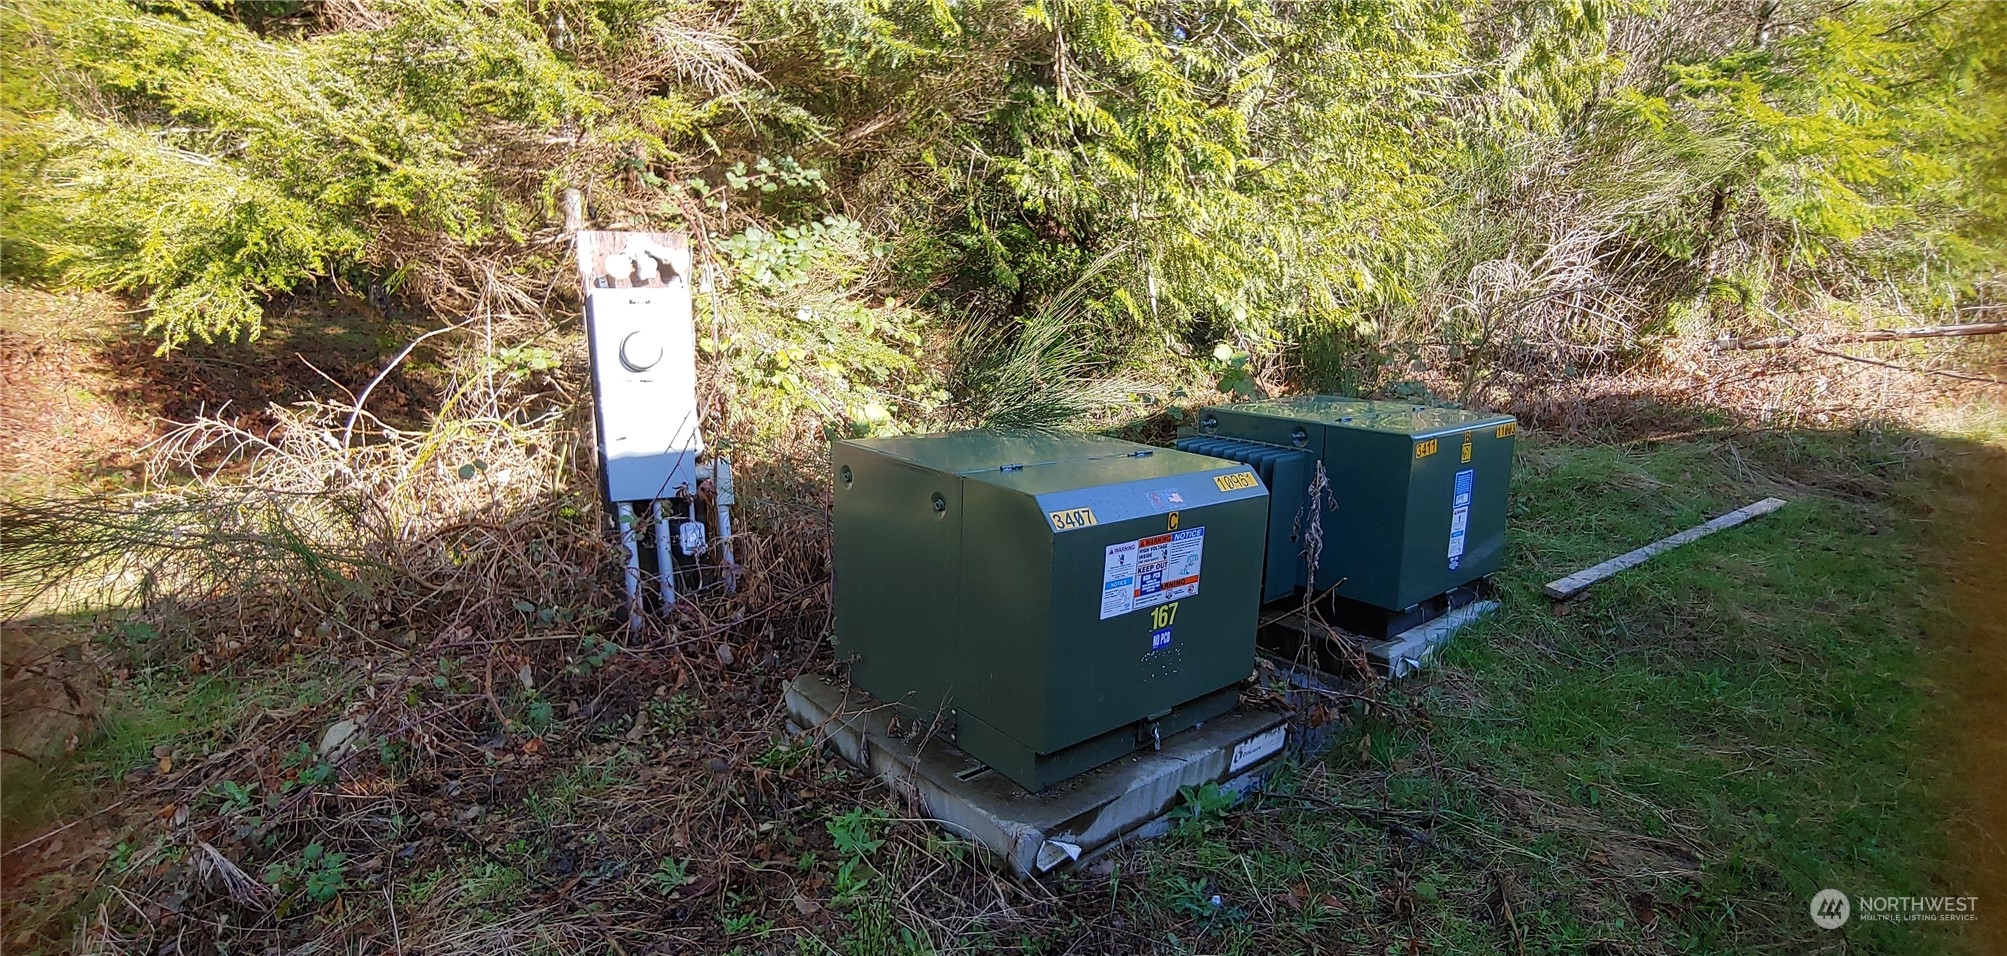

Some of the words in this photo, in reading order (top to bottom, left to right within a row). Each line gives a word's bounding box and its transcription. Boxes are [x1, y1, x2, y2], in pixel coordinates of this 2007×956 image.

[1416, 440, 1437, 458] 3411
[1217, 473, 1256, 490] 10961
[1052, 509, 1092, 529] 3407
[1169, 512, 1178, 529] C
[1145, 535, 1171, 546] WARNING
[1174, 529, 1201, 541] NOTICE
[1114, 544, 1136, 554] WARNING
[1137, 564, 1155, 574] KEEP
[1155, 562, 1168, 570] OUT
[1110, 579, 1127, 588] NOTICE
[1162, 578, 1186, 589] ARNING
[1151, 602, 1179, 630] 167
[1153, 634, 1160, 647] NO
[1160, 631, 1171, 645] PCB
